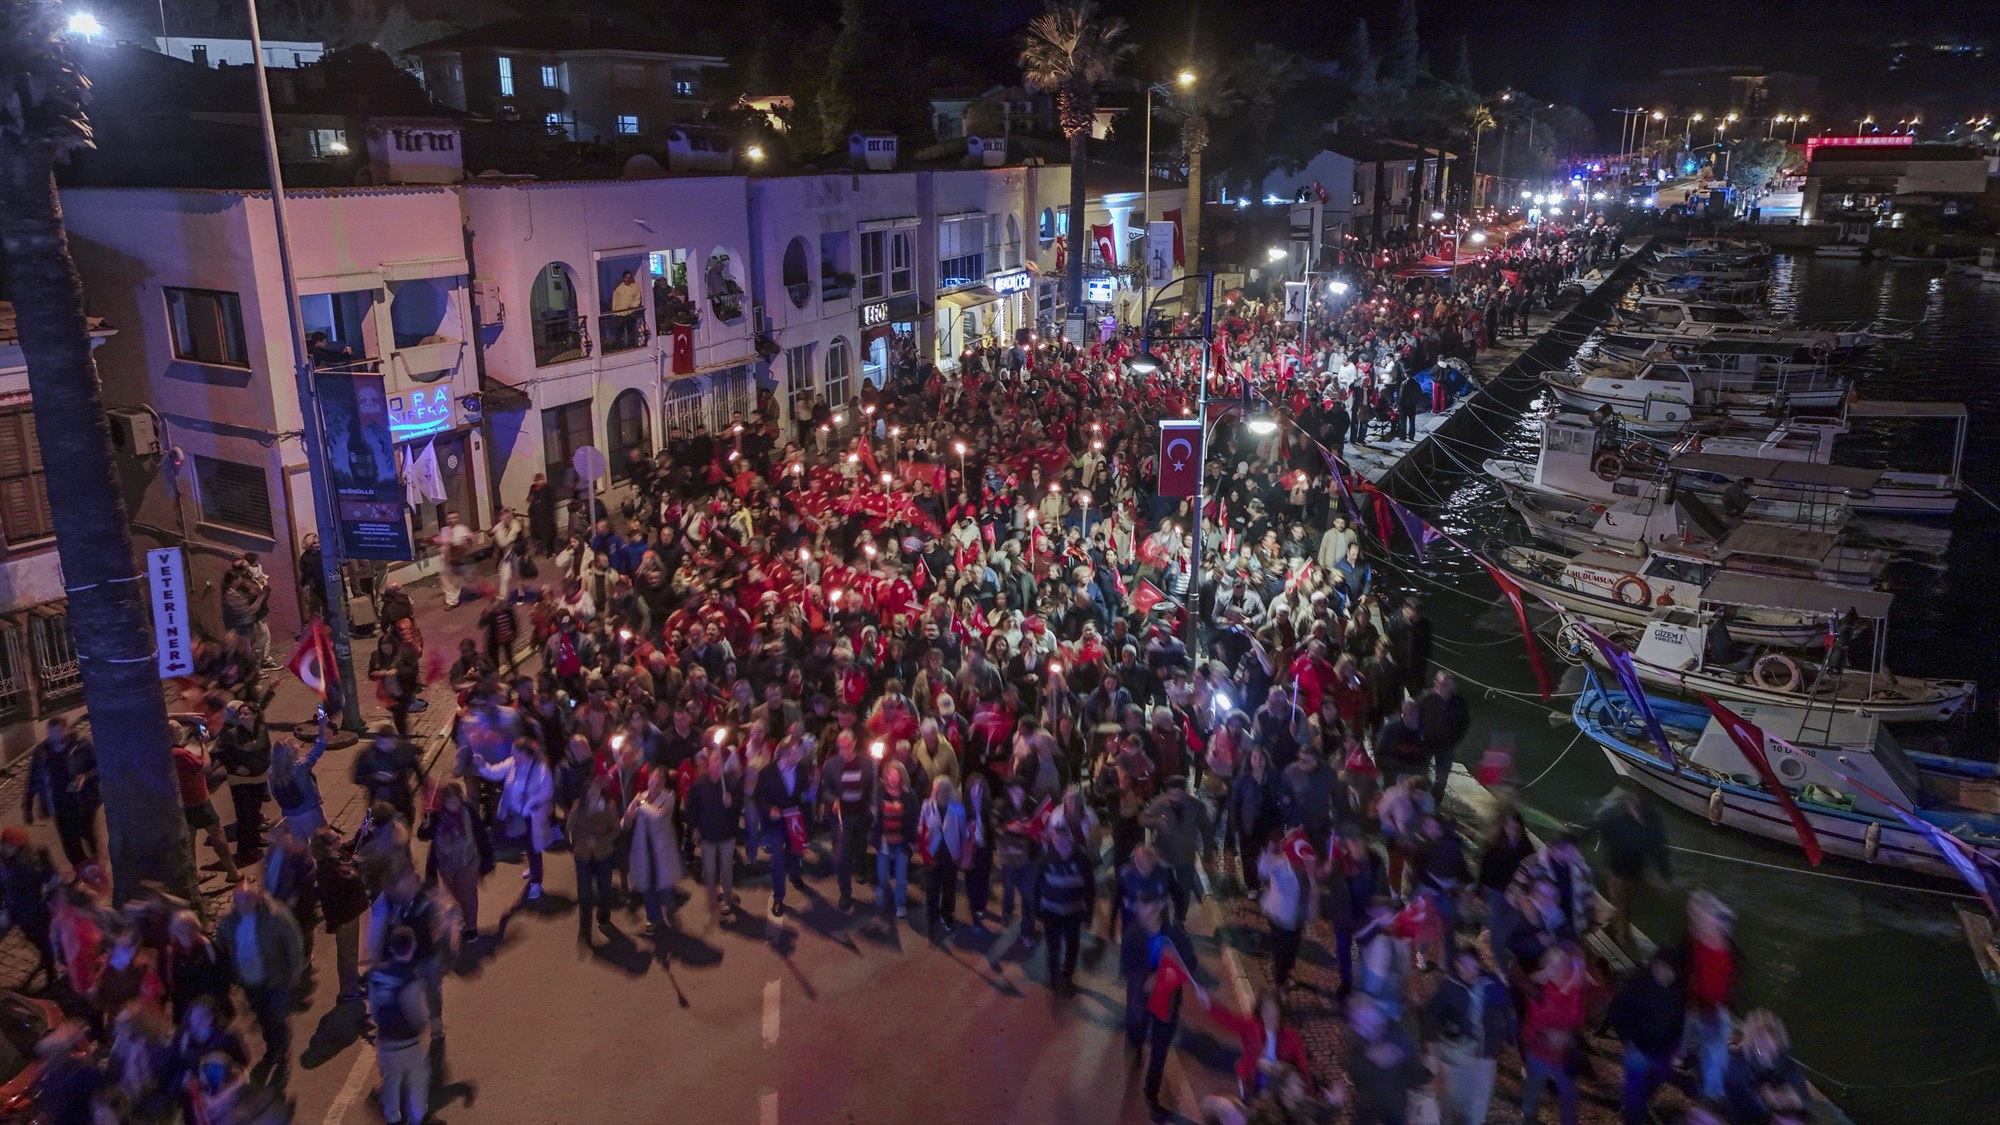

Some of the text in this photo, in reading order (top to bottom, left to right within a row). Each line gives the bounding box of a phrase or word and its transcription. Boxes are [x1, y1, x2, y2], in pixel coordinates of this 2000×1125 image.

[389, 389, 448, 412] ORA
[389, 404, 449, 425] NIFERA
[159, 554, 180, 660] VETERİNER
[1654, 629, 1678, 640] GİZEM
[1772, 745, 1783, 753] 10
